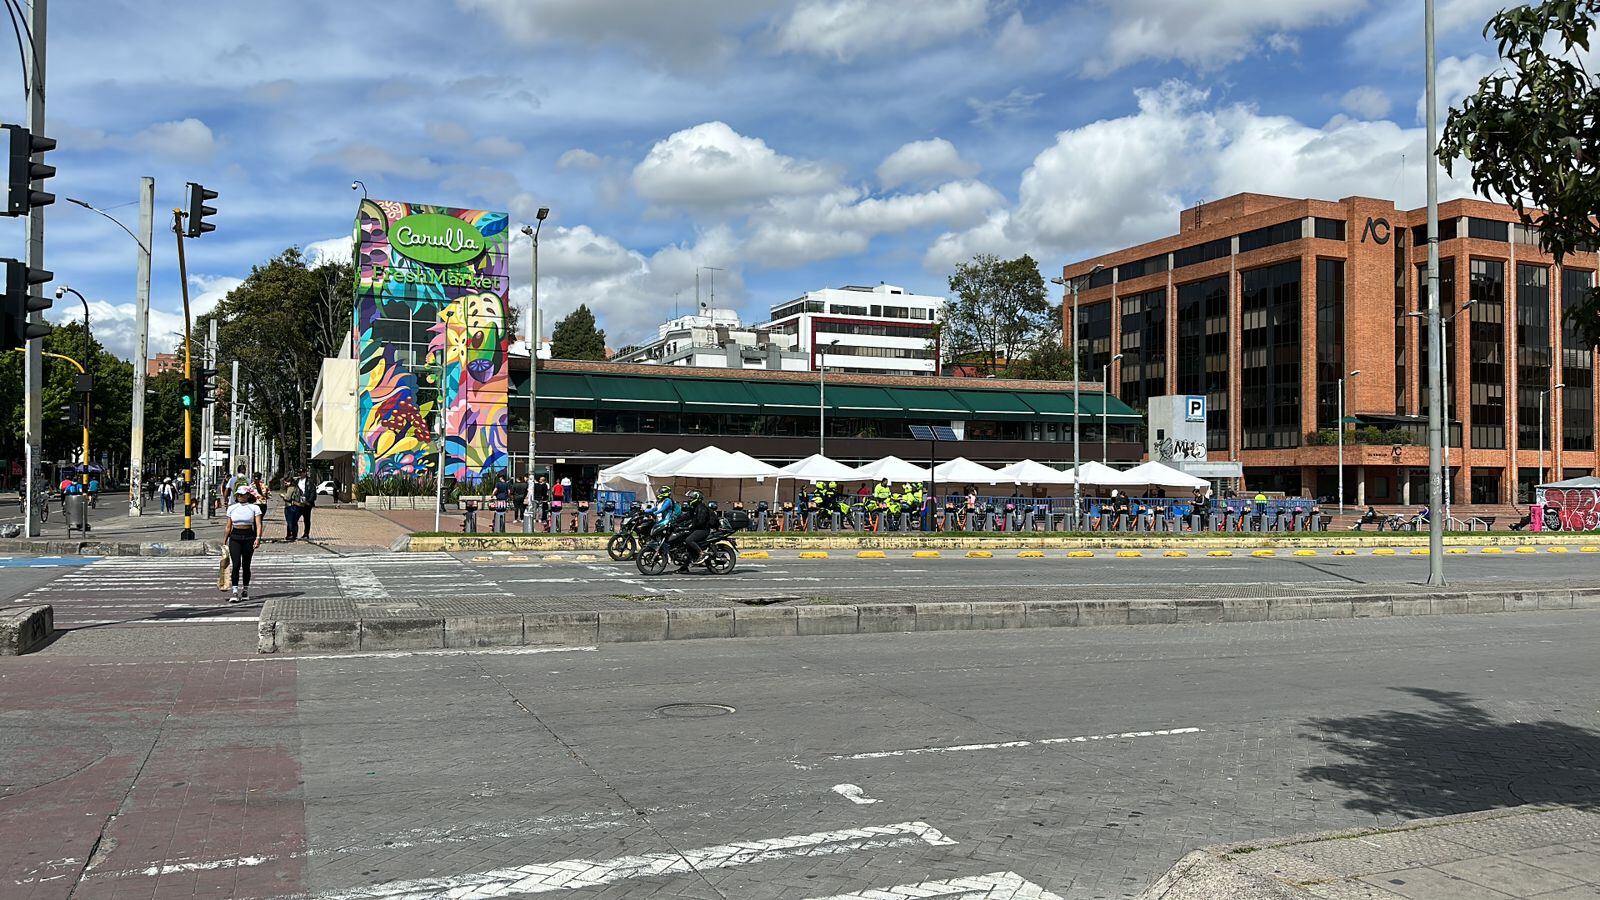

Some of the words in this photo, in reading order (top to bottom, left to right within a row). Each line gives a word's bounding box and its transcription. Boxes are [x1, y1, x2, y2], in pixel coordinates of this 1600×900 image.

[397, 226, 479, 252] Carulla
[1361, 217, 1390, 245] AC
[372, 265, 501, 290] FreshMarket
[1191, 401, 1201, 415] P
